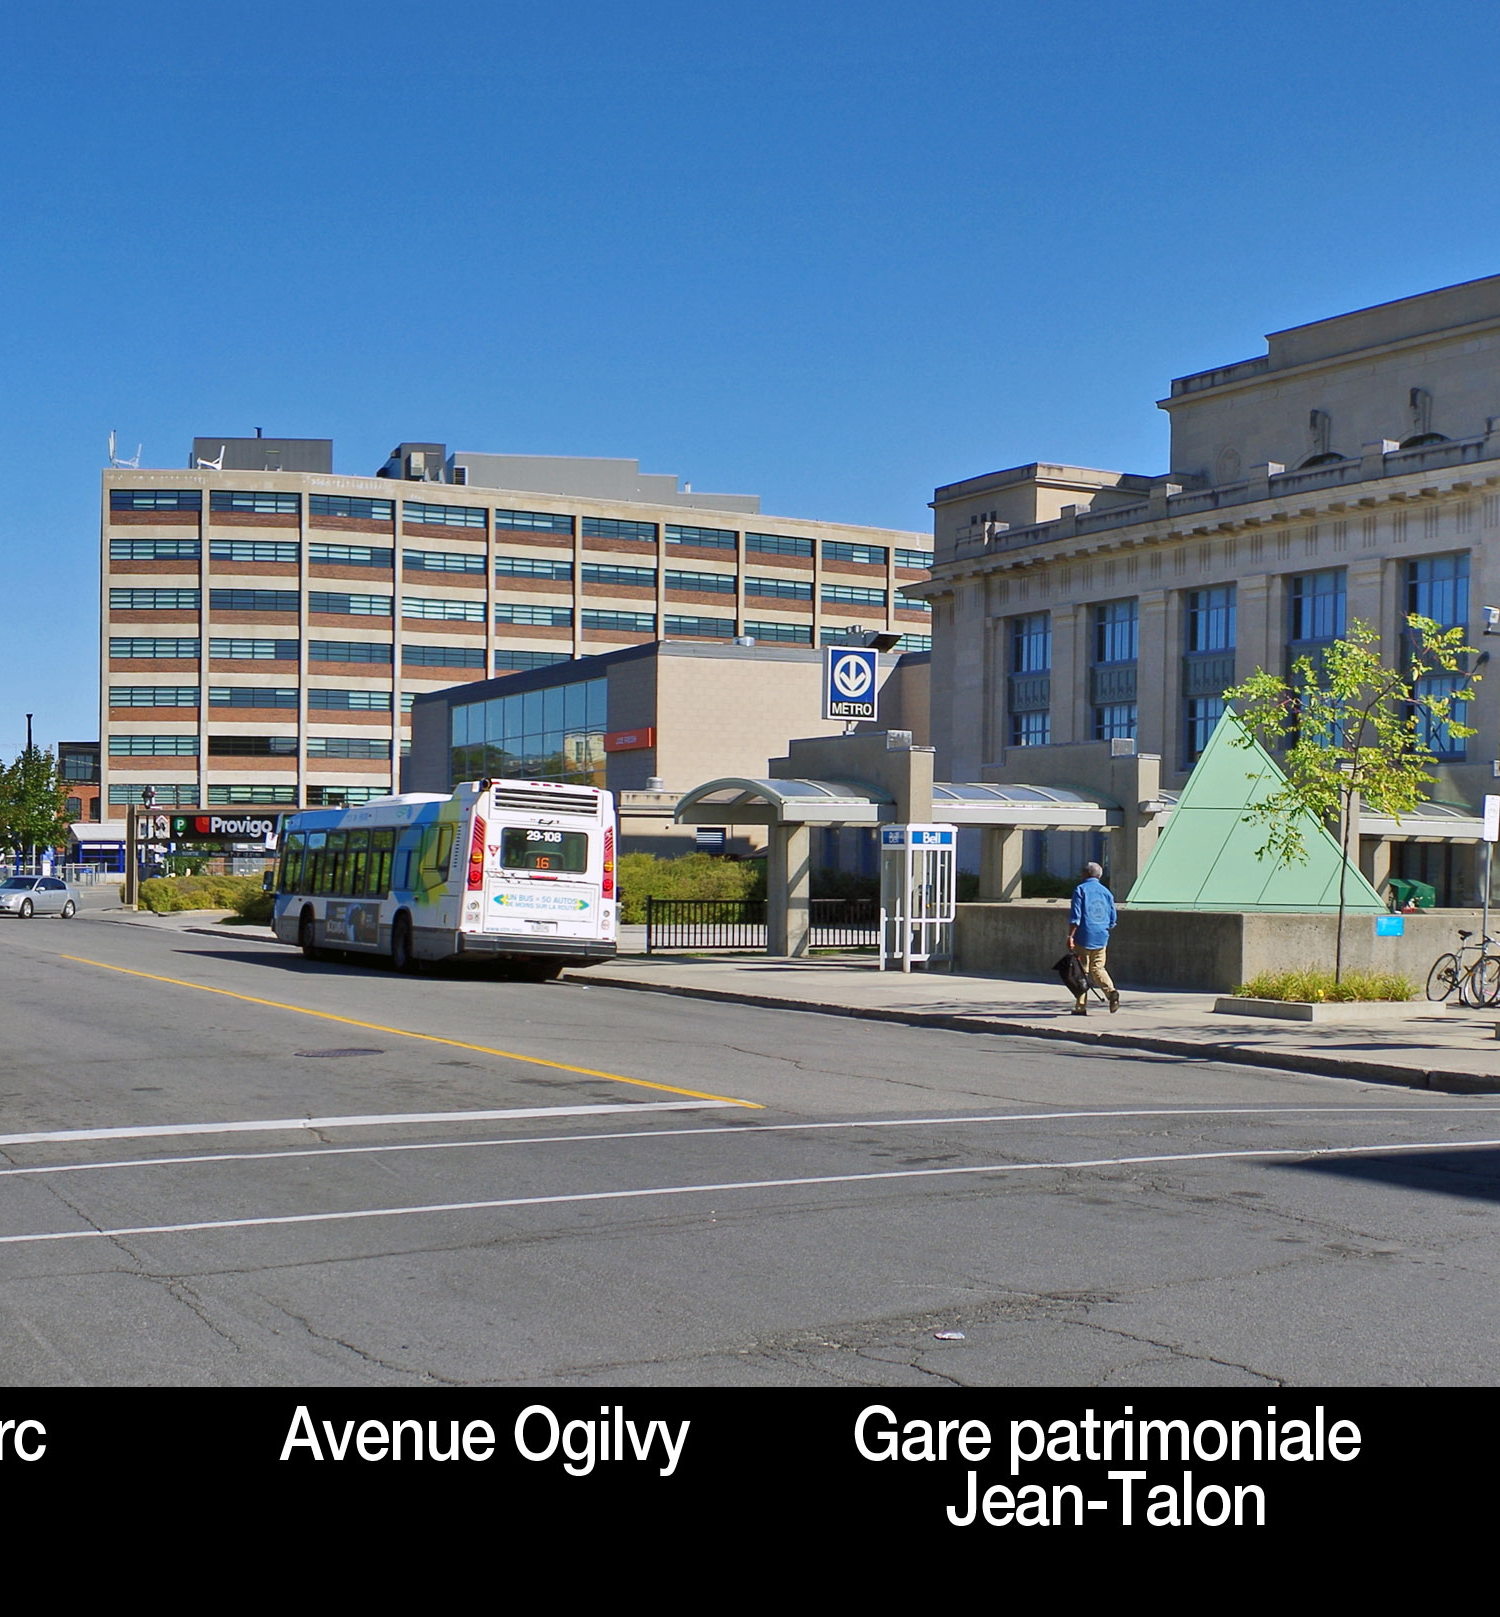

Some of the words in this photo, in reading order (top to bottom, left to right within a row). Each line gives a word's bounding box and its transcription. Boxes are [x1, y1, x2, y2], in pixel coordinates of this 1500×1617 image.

[177, 819, 185, 829] P
[211, 816, 273, 838] Provigo
[526, 830, 562, 843] 29-108
[923, 831, 941, 844] Bell
[536, 857, 549, 869] 16
[519, 894, 534, 902] BUS
[554, 896, 577, 905] AUTOS
